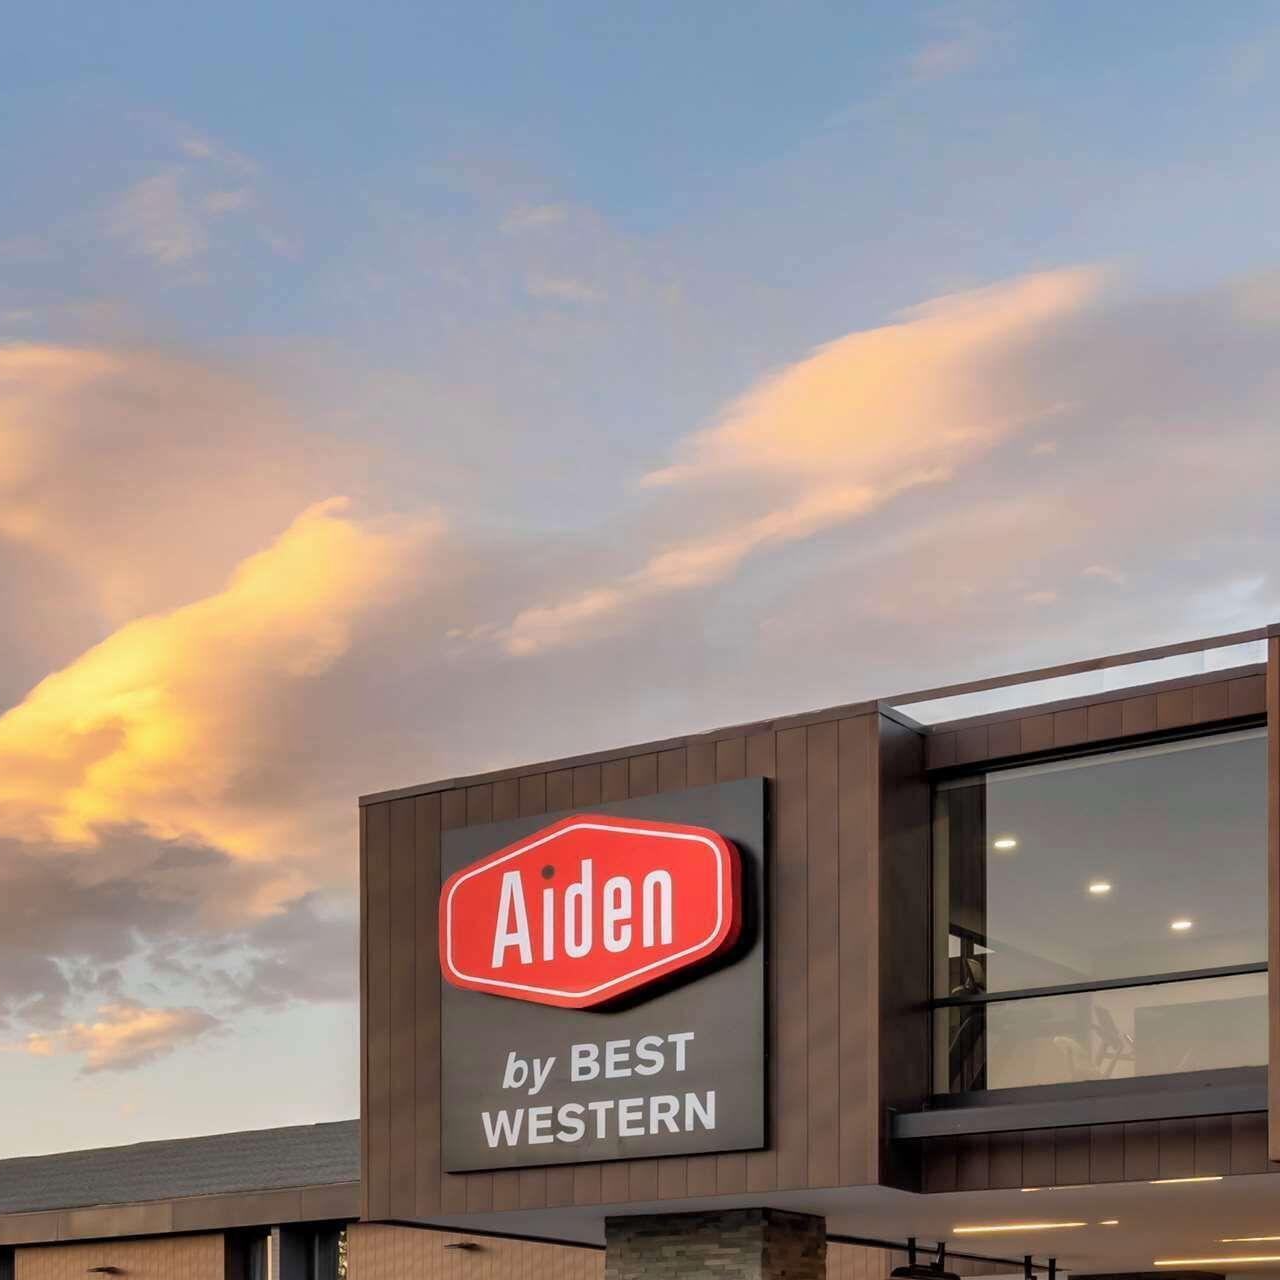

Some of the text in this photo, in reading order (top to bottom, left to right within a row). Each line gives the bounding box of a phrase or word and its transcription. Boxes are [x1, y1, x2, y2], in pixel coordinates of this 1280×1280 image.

[491, 858, 673, 968] Aiden
[502, 1032, 695, 1095] by BEST
[481, 1091, 717, 1148] WESTERN
